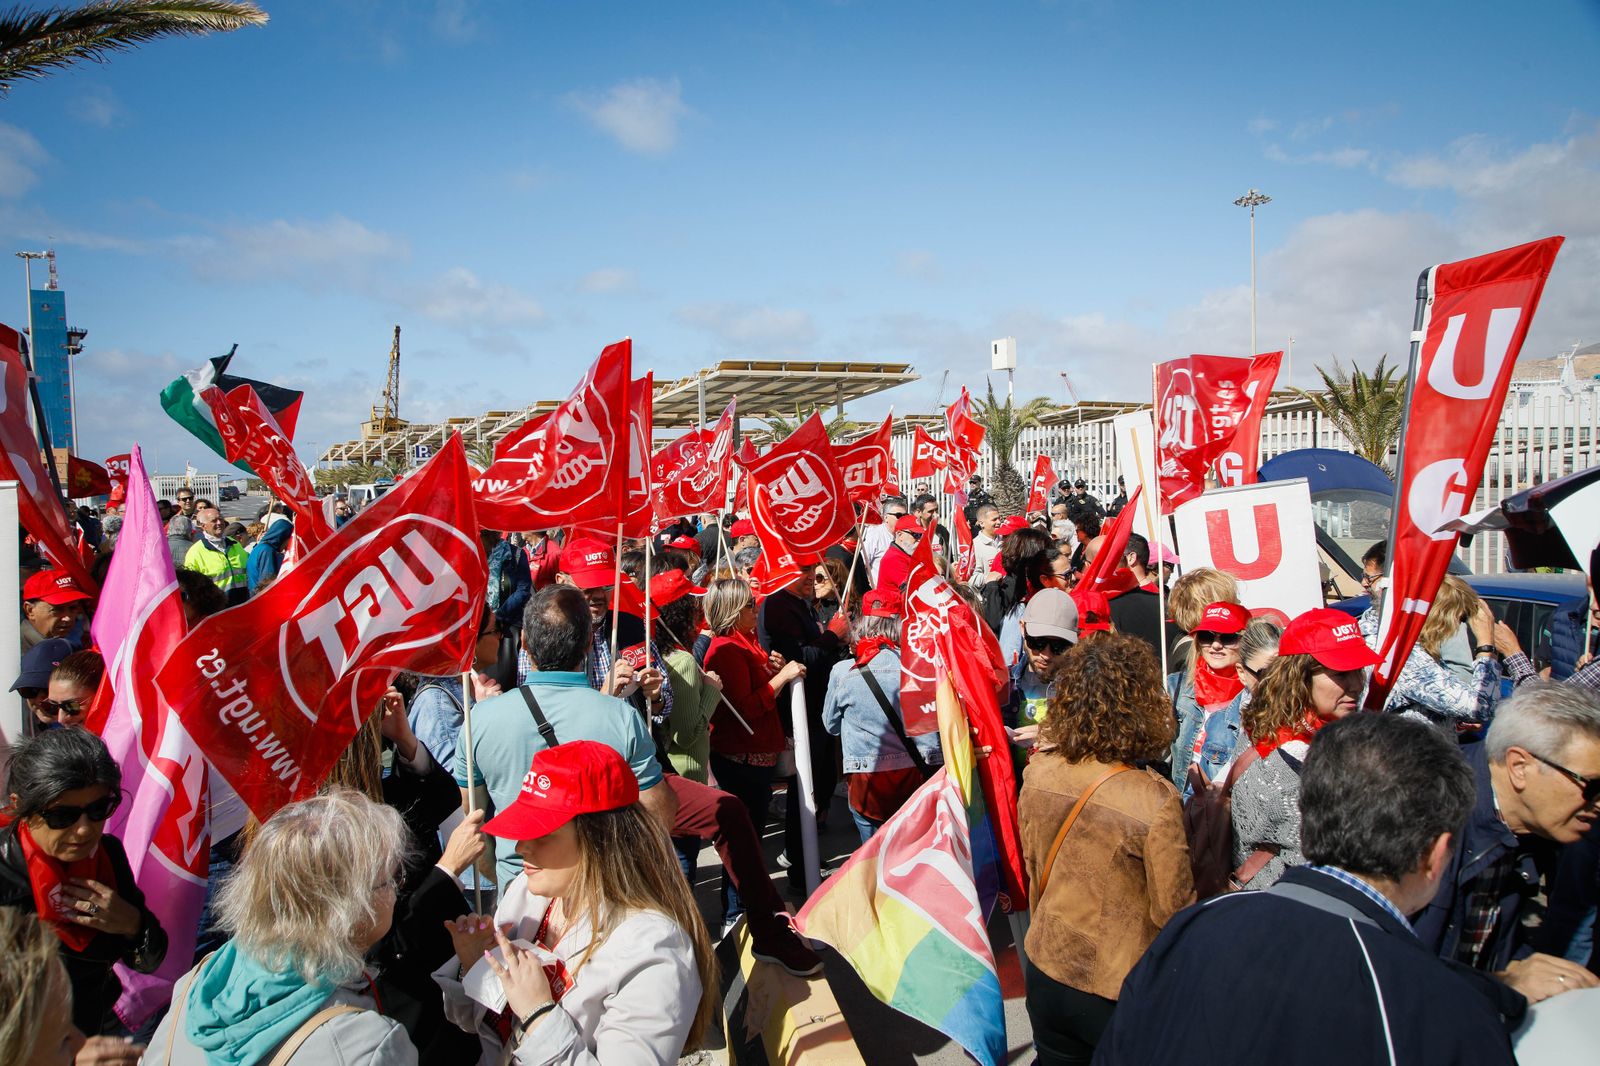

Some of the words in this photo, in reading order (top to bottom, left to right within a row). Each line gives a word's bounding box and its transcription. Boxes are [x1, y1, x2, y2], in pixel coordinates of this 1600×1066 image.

[839, 453, 882, 489] GT
[585, 552, 602, 561] UGT
[55, 577, 72, 585] UGT
[1331, 623, 1354, 637] UGT
